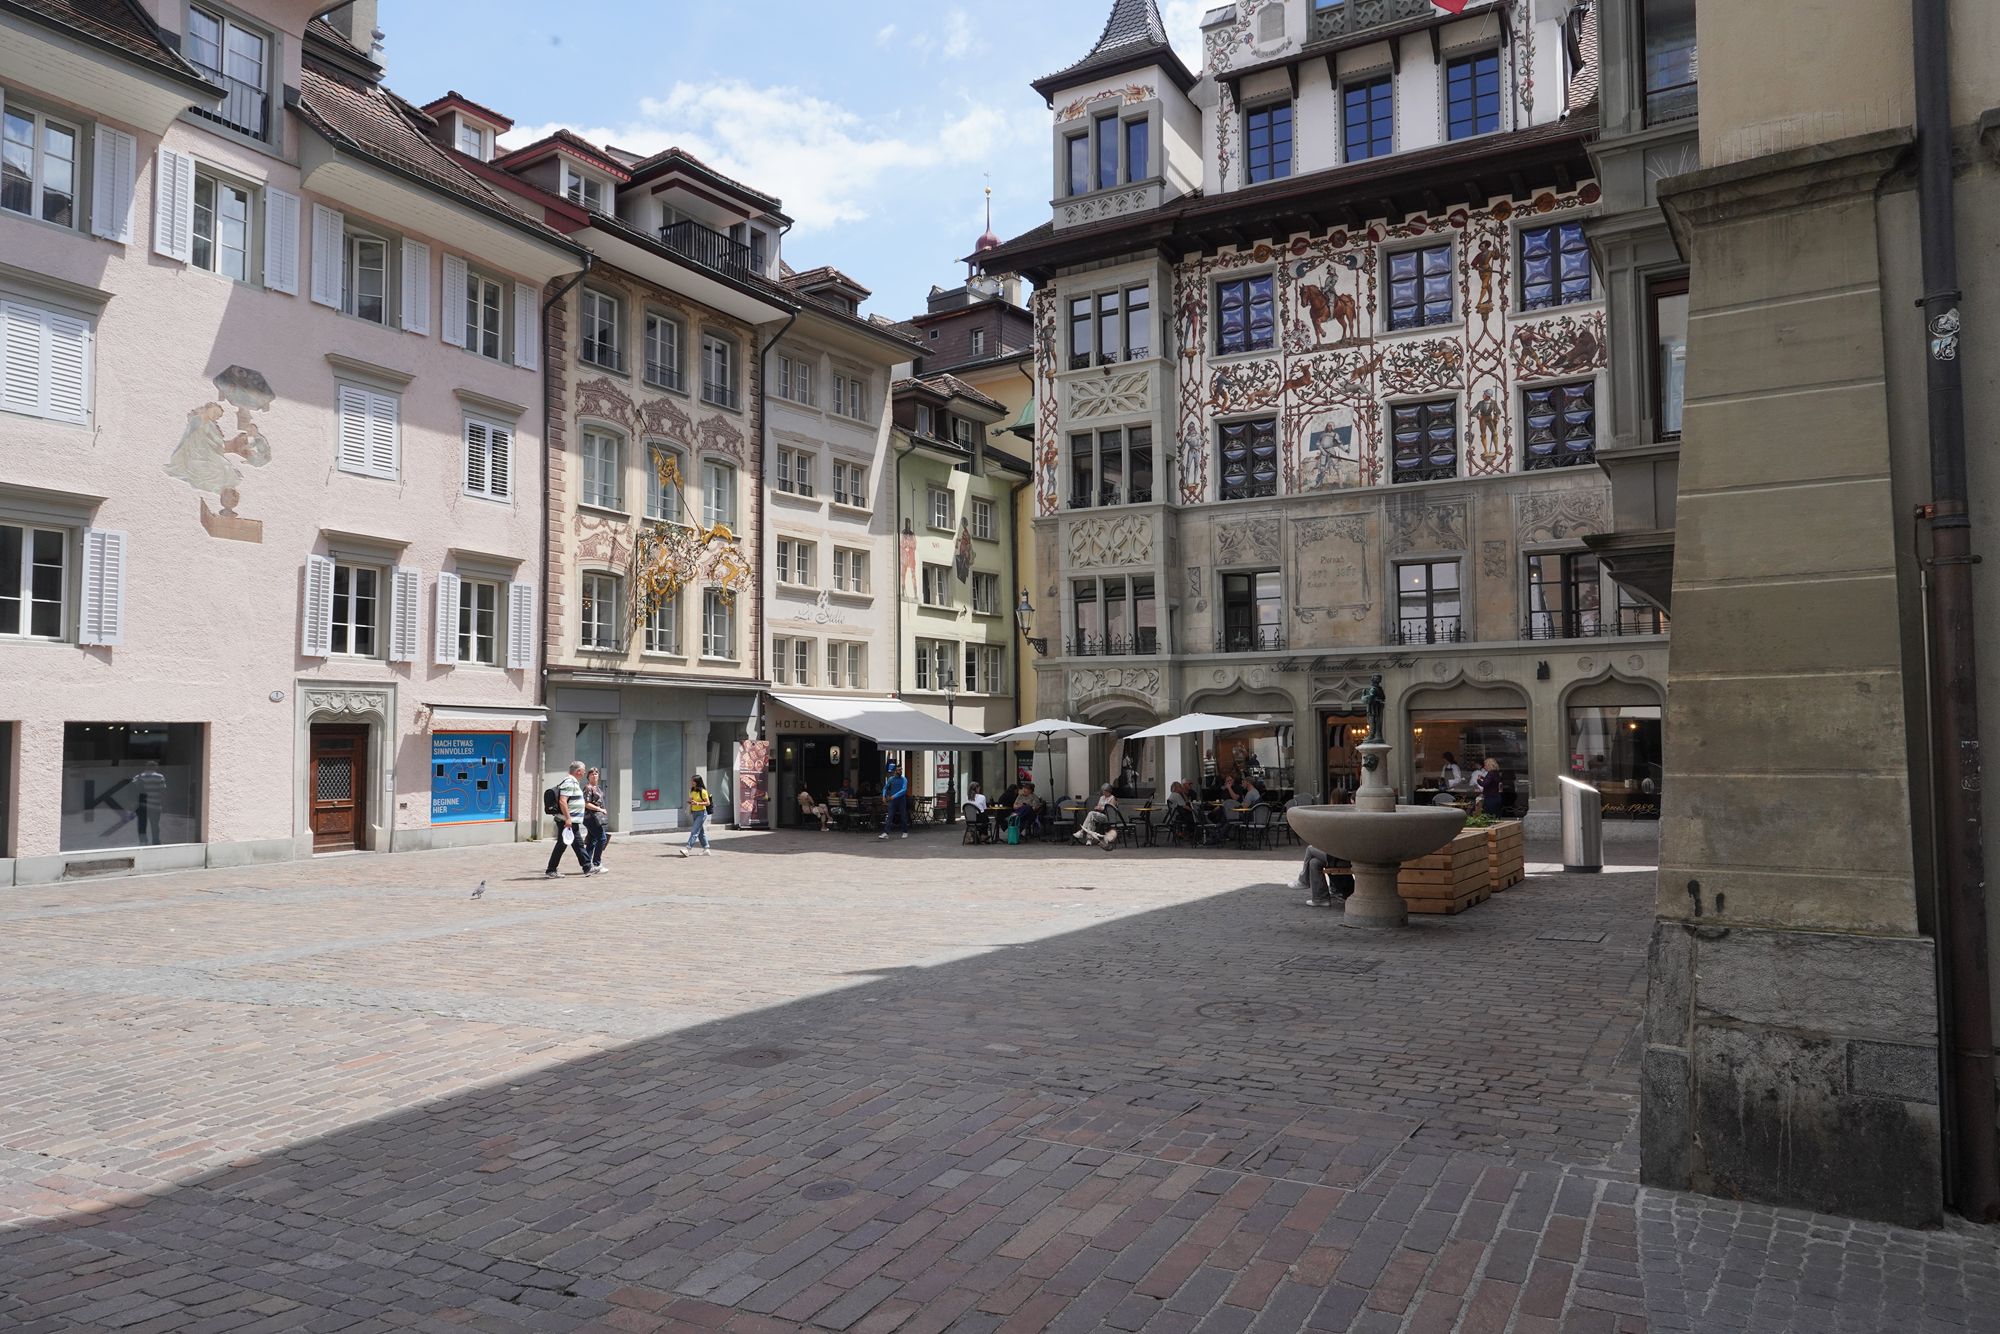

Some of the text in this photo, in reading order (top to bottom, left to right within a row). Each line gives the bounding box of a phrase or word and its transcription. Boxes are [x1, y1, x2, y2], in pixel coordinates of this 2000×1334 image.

[1369, 658, 1381, 670] de
[1383, 653, 1420, 669] Fred
[775, 720, 813, 729] HOTEL
[453, 739, 473, 747] ETWAS
[432, 798, 459, 806] BEGINNE
[432, 806, 448, 814] HIER
